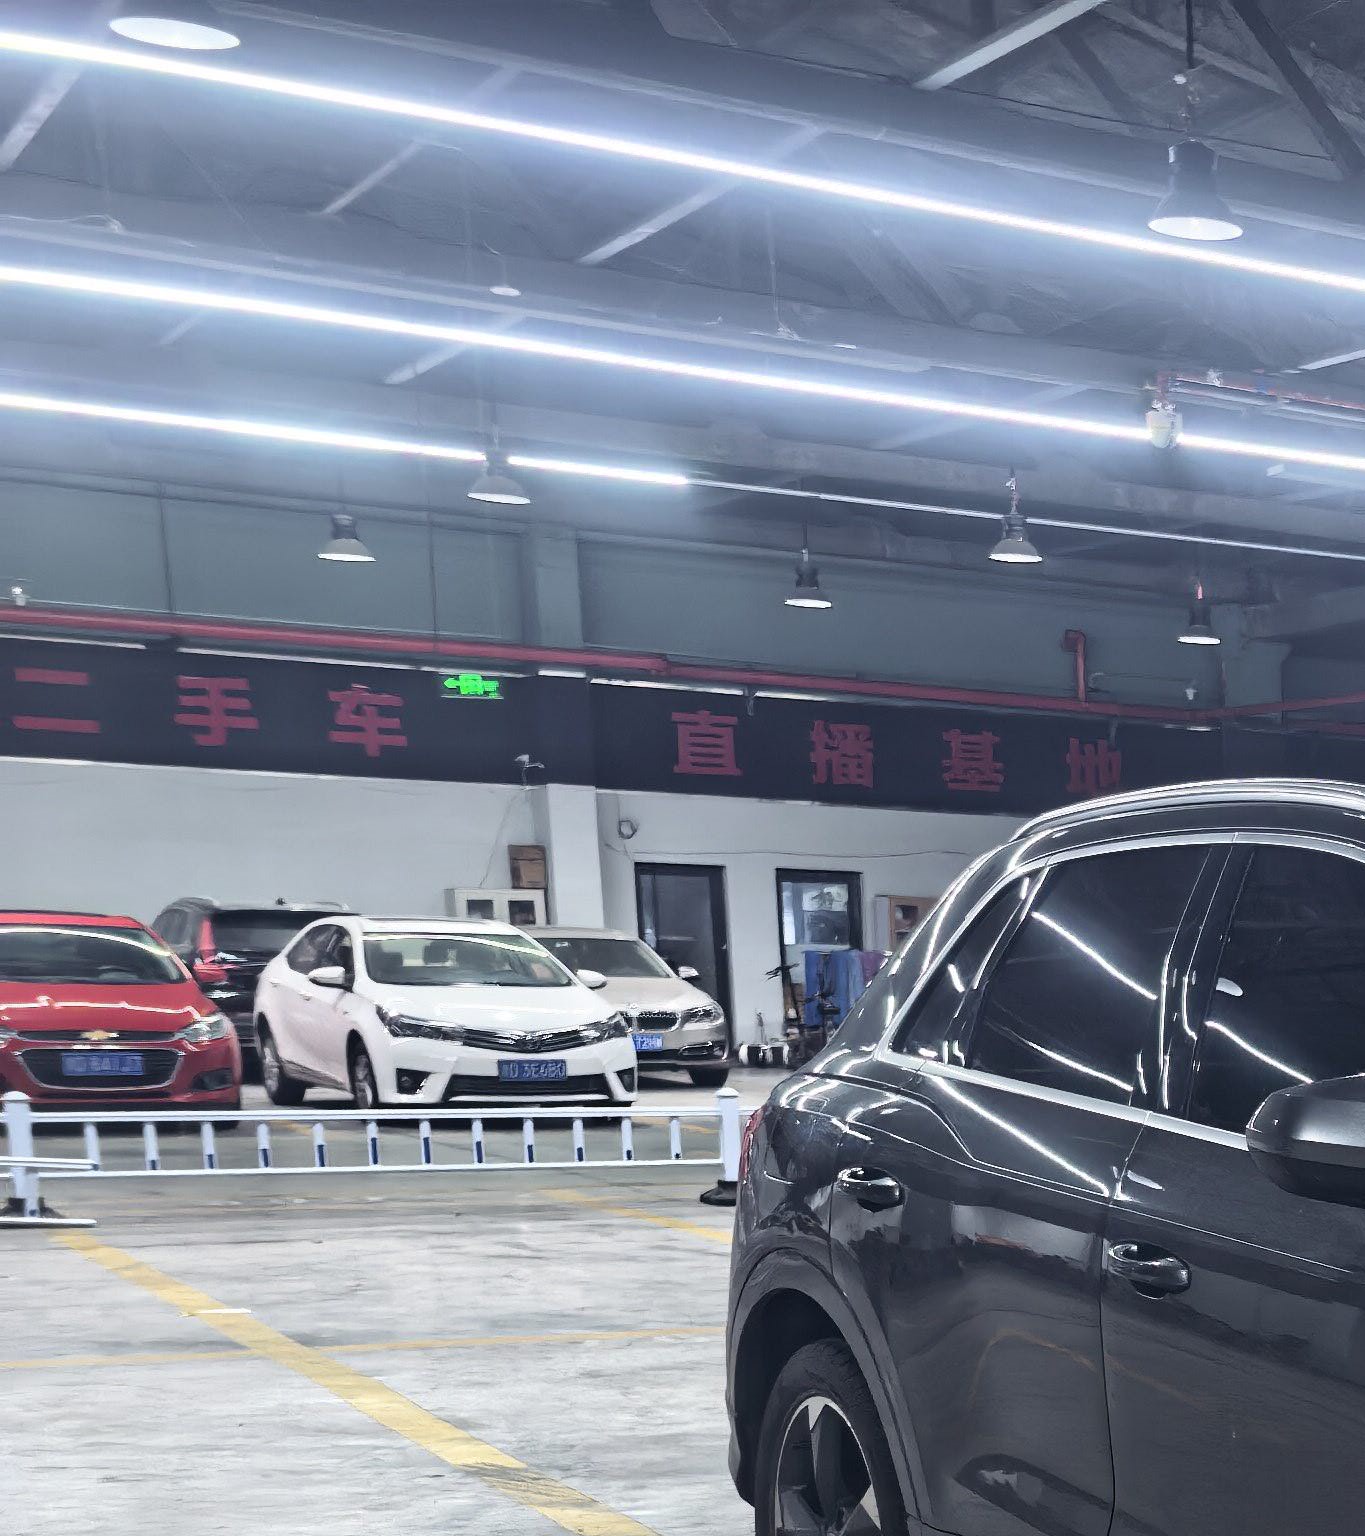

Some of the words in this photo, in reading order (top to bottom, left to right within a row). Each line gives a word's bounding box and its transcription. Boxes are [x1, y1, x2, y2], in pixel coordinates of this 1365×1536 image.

[13, 666, 409, 758] 二手车
[671, 710, 1122, 794] 直播基地
